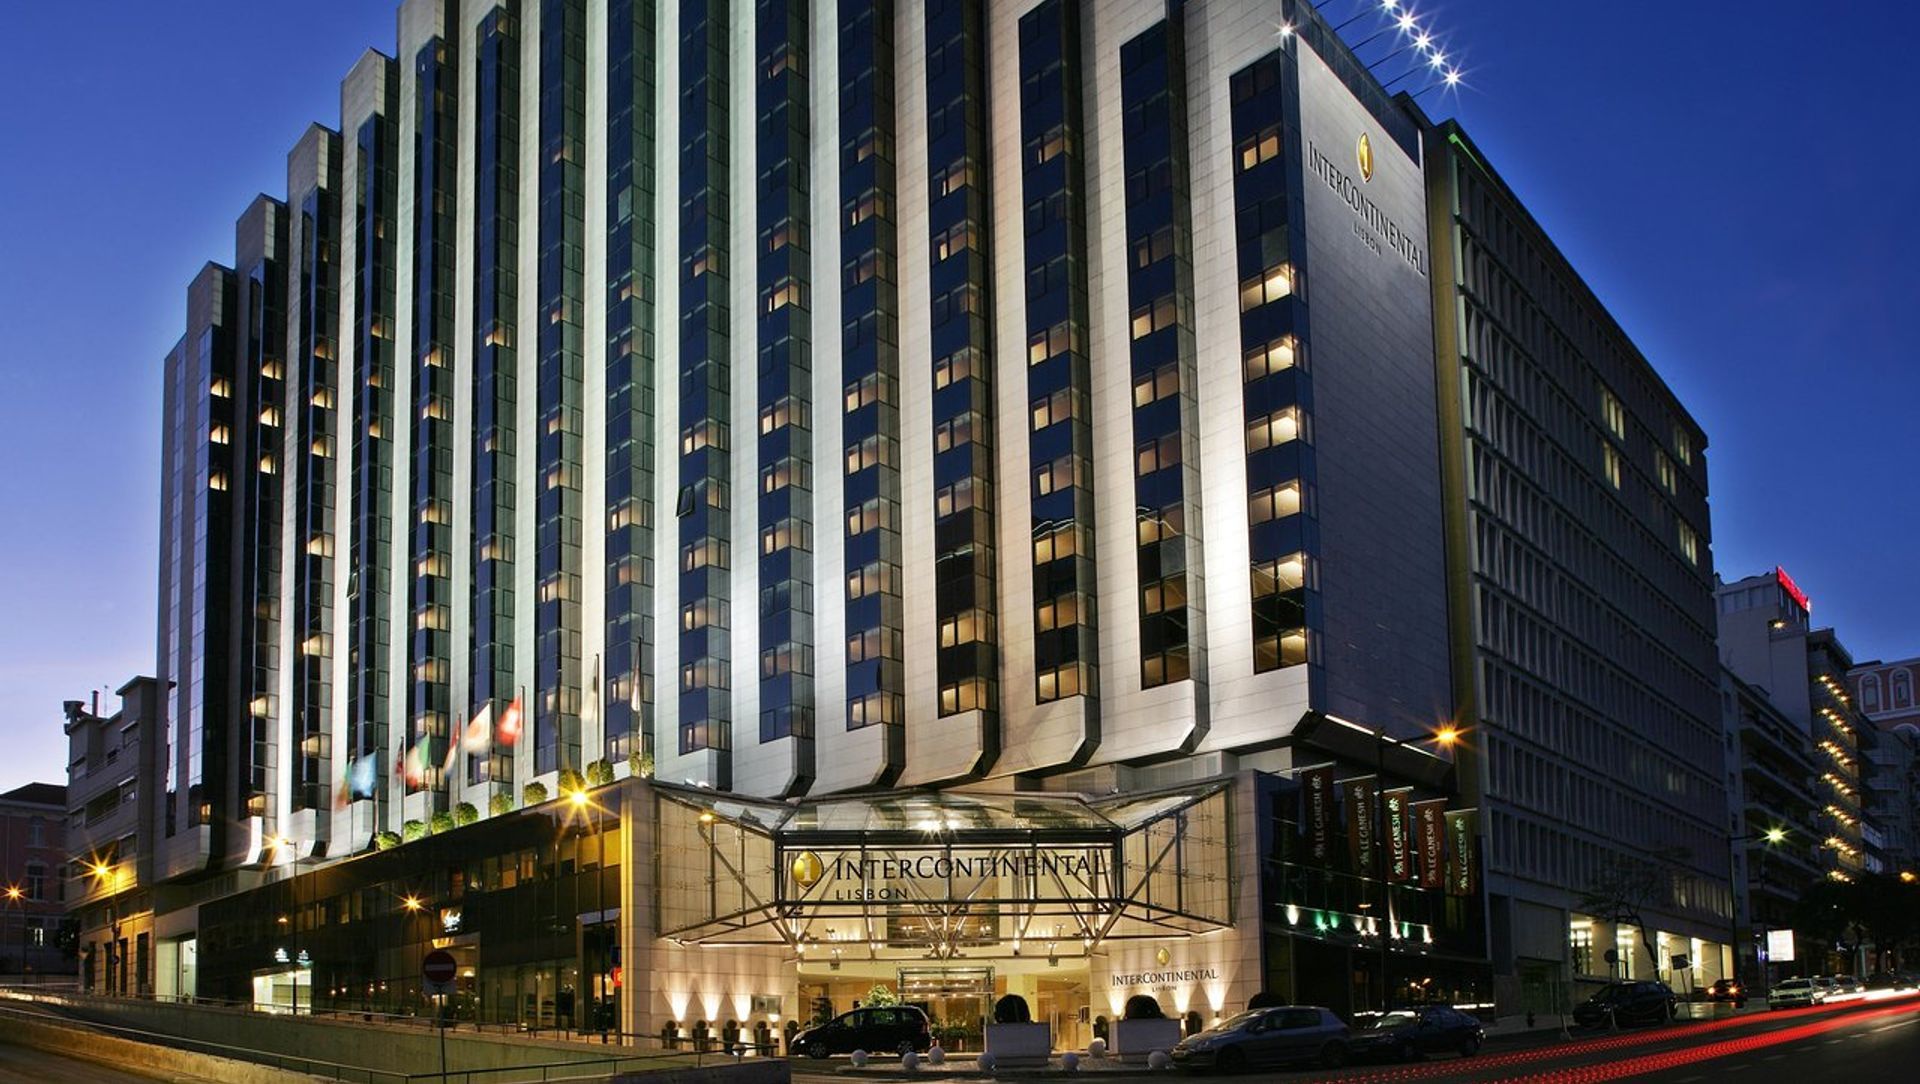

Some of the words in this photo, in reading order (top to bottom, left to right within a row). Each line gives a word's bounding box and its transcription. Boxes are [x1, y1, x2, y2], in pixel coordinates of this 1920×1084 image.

[1309, 141, 1426, 276] INTERCONTINENTAL
[1354, 222, 1382, 256] LISBON
[1391, 814, 1403, 848] GANESH
[1393, 849, 1404, 860] LE
[835, 855, 1109, 881] INTERCONTINENTAL
[835, 887, 909, 901] LISBON
[1112, 969, 1219, 986] INTERCONTINENTAL
[1152, 985, 1177, 993] LISBON
